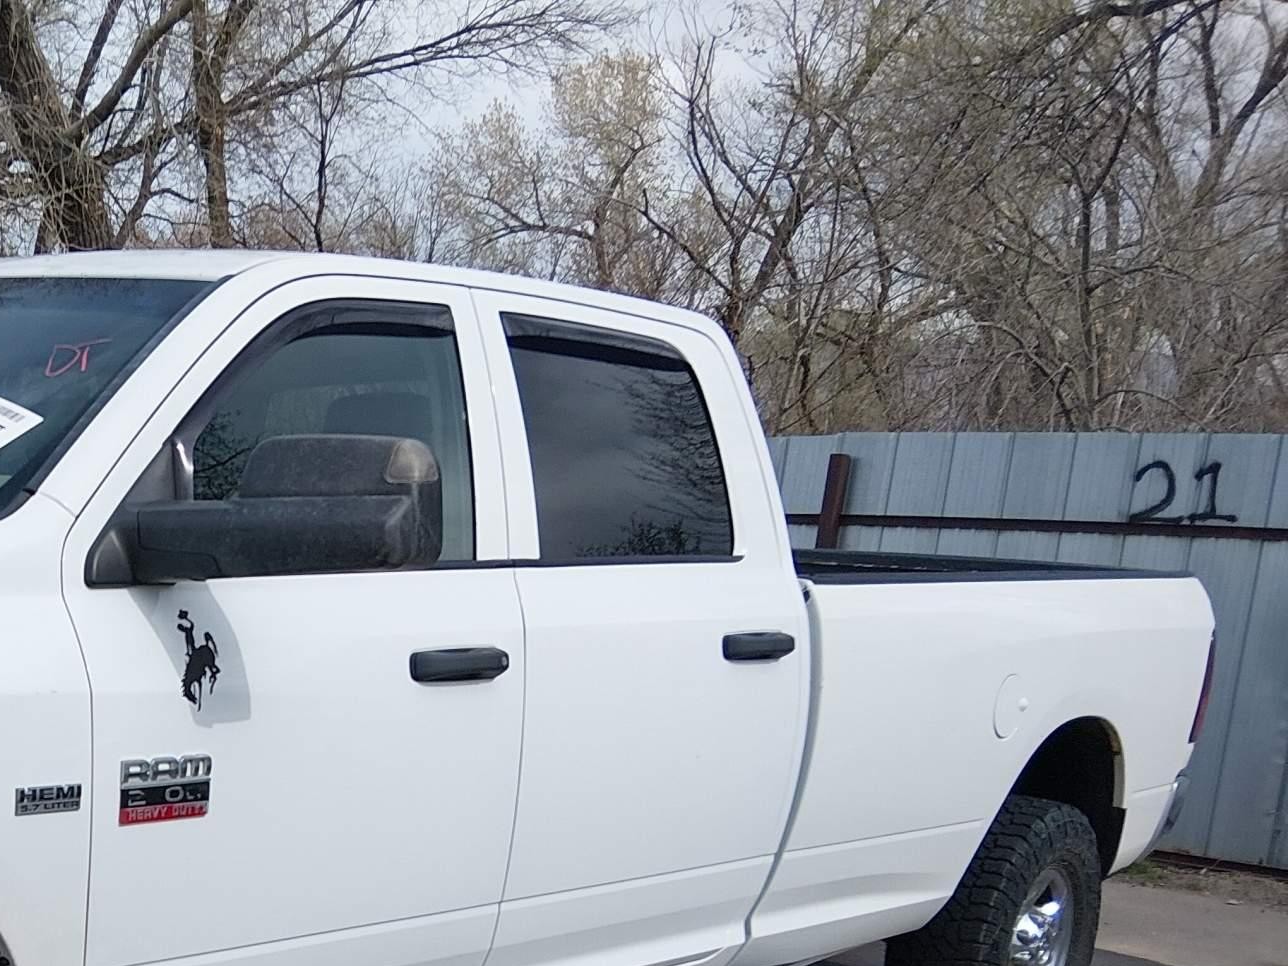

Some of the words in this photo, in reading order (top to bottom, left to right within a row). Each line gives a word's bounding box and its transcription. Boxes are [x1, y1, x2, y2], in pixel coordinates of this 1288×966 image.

[1129, 460, 1238, 523] 21
[120, 754, 212, 783] RAM
[19, 784, 82, 802] HEMI
[44, 800, 79, 810] LITER
[128, 807, 168, 820] HEAVY
[172, 803, 207, 817] DUTY
